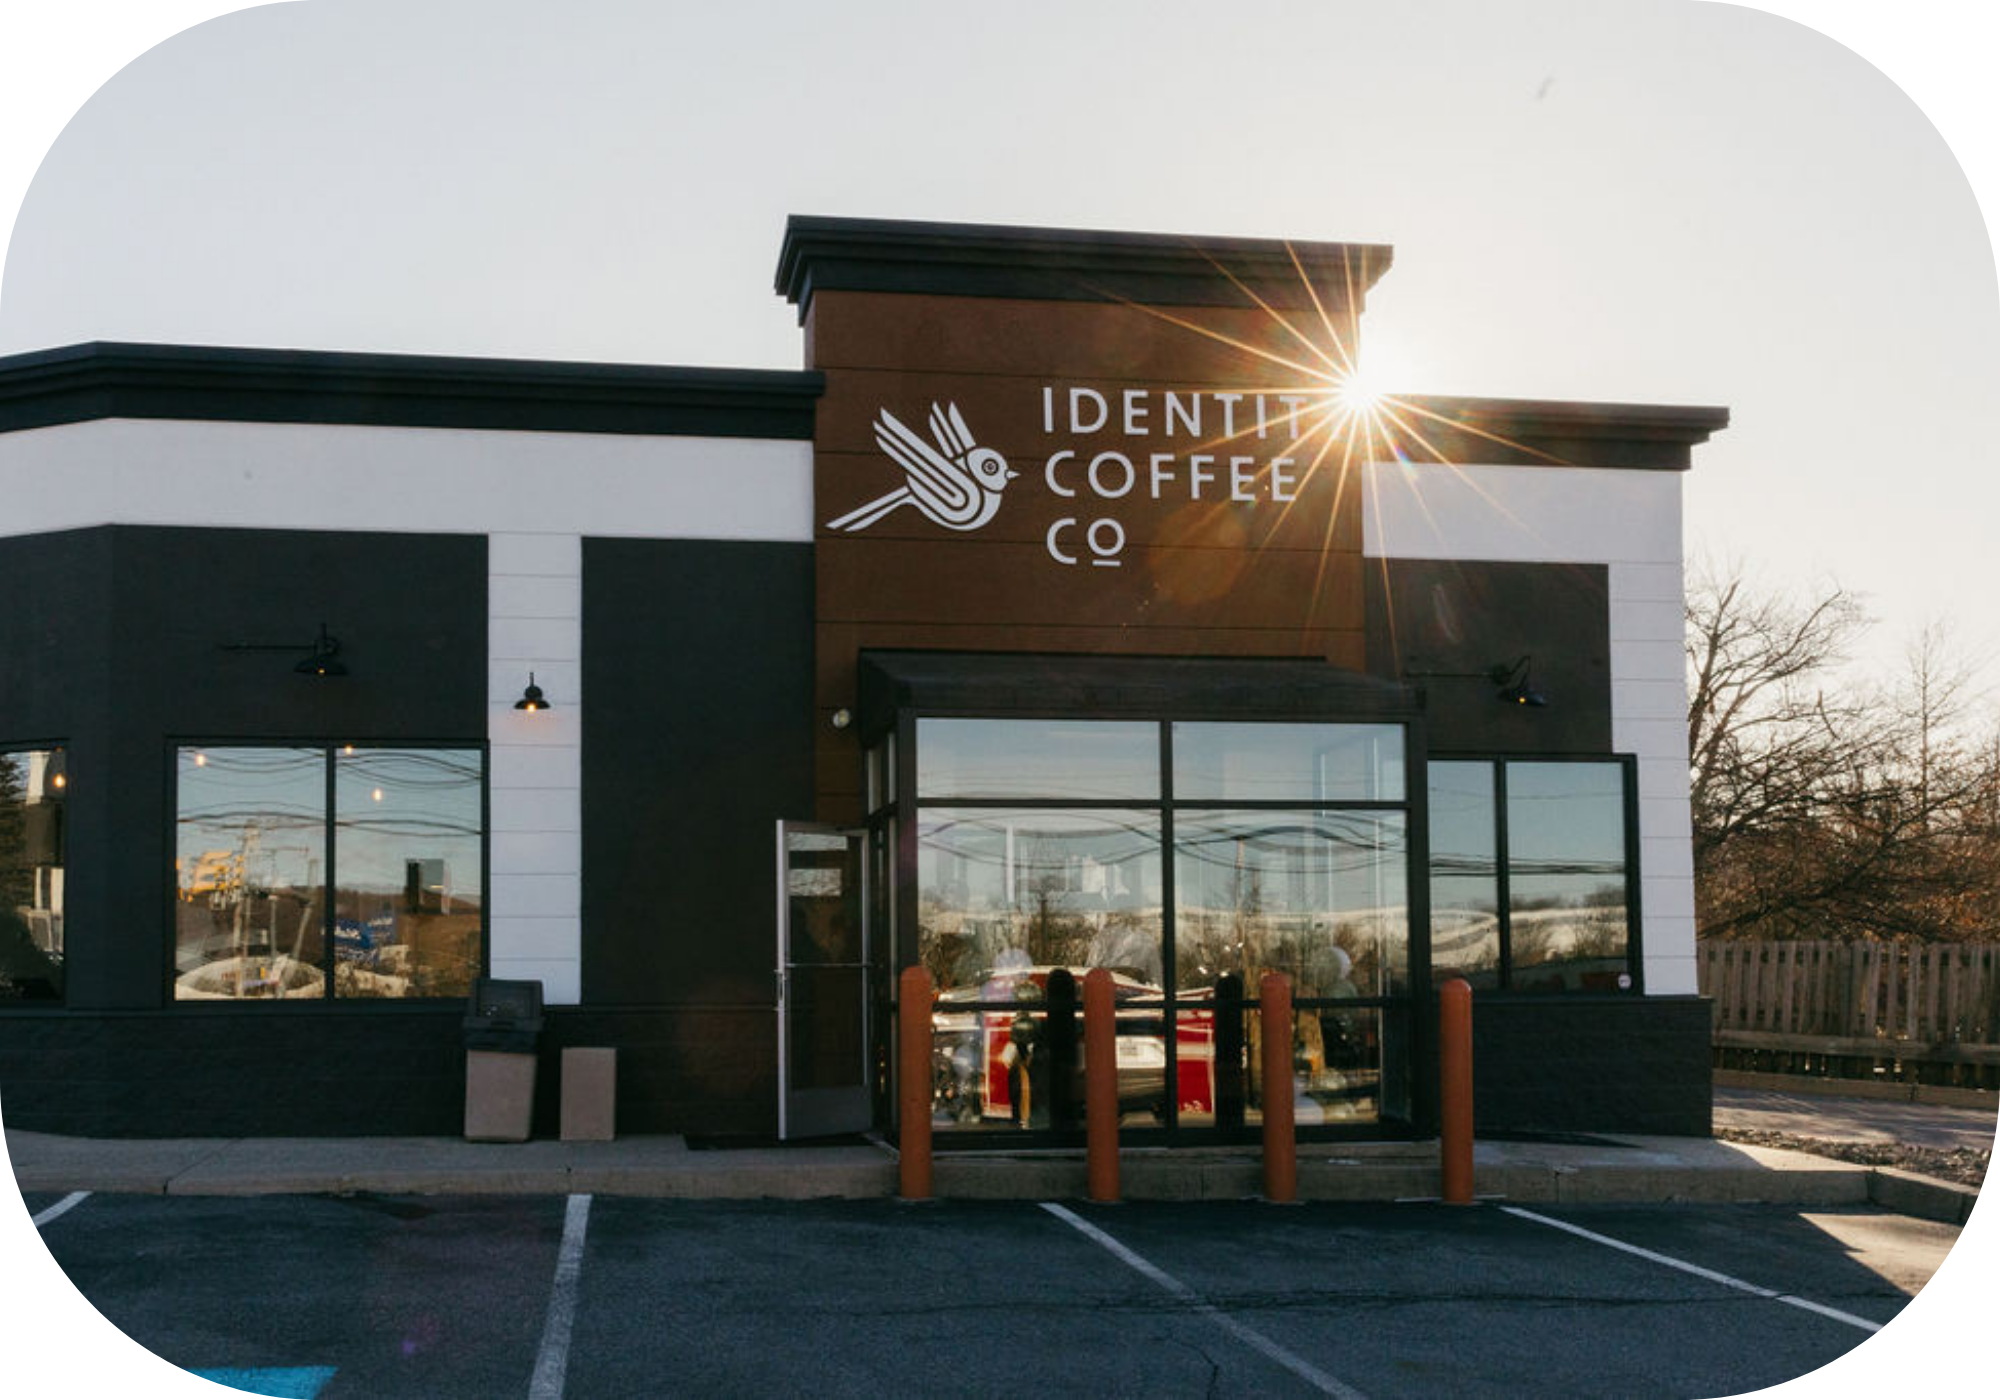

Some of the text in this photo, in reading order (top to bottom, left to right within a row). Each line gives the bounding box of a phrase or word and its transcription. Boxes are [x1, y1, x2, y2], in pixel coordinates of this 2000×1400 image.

[1043, 386, 1347, 440] IDENTIT
[1045, 450, 1296, 502] COFFEE
[1046, 518, 1125, 566] CO
